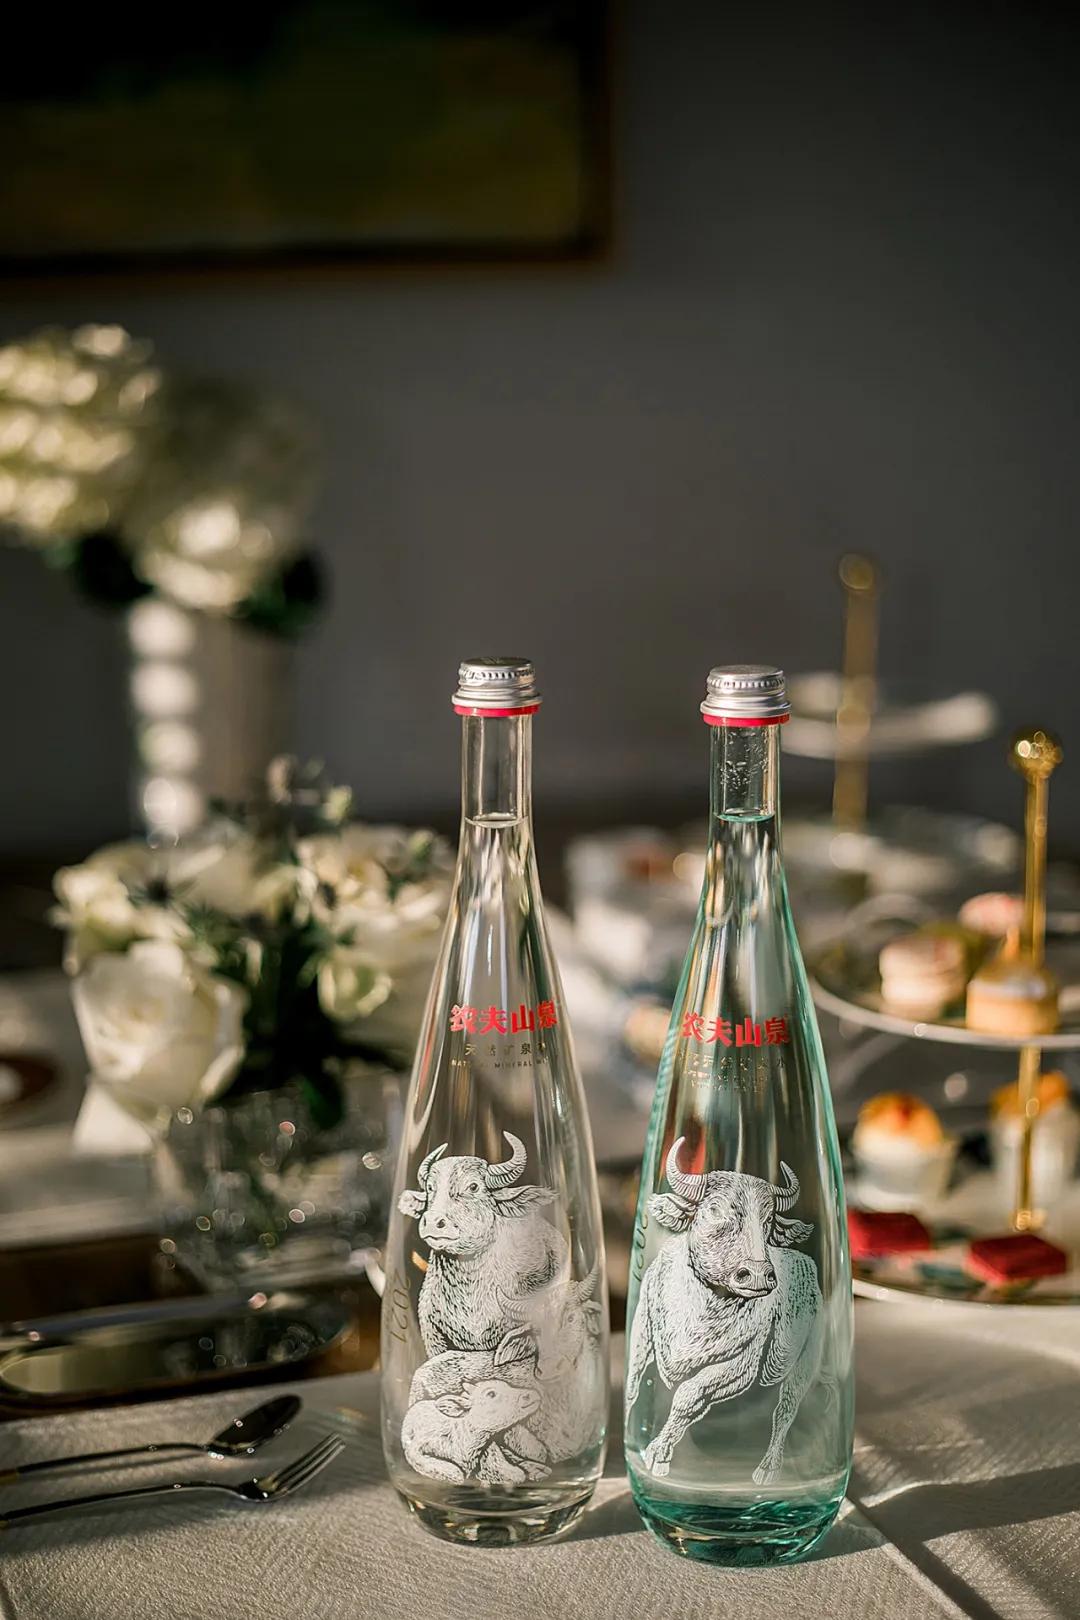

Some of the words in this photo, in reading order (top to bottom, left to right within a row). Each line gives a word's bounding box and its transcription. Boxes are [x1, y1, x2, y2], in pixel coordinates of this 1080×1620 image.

[449, 1000, 558, 1035] 农夫山泉
[682, 1011, 789, 1047] 农夫山泉
[390, 1268, 411, 1343] 2021
